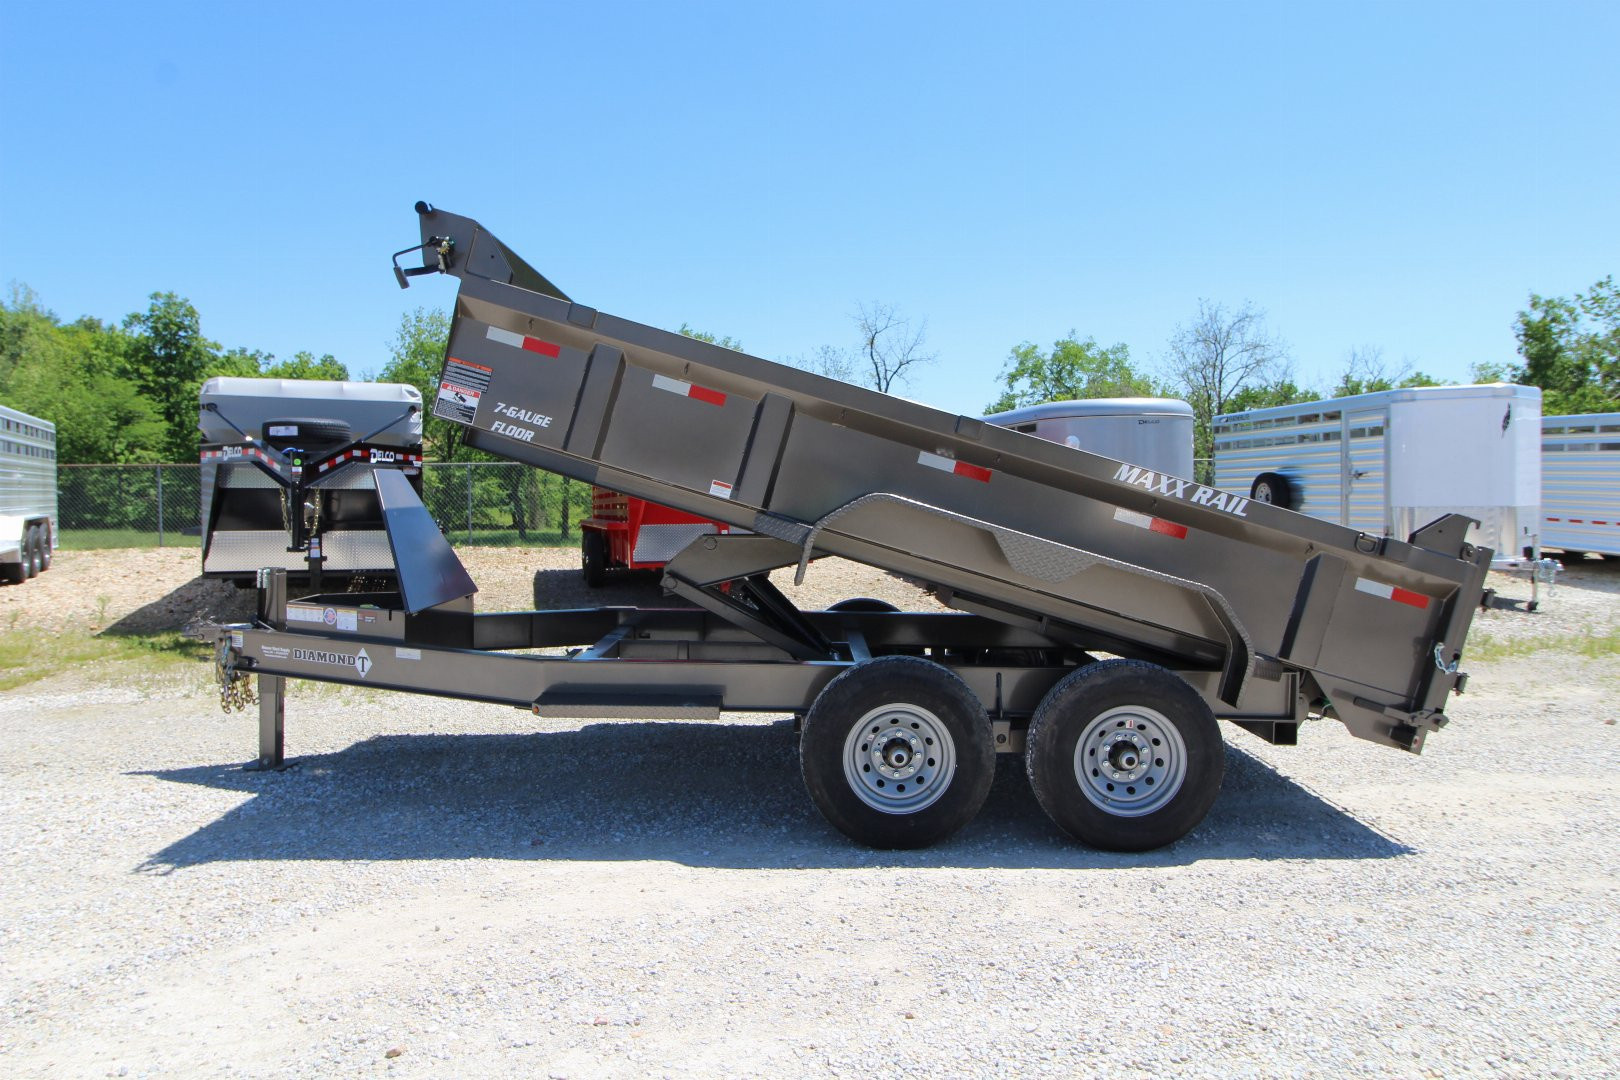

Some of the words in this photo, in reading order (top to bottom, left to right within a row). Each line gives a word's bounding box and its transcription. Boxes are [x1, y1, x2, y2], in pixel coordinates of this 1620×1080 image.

[493, 402, 553, 428] 7-GAUGE
[490, 420, 535, 442] FLOOR
[222, 445, 243, 461] DELCO
[369, 448, 395, 464] DELCO
[1112, 463, 1192, 499] MAXX
[1190, 486, 1249, 517] RAIL
[293, 648, 356, 667] DIAMOND
[357, 656, 369, 673] T
